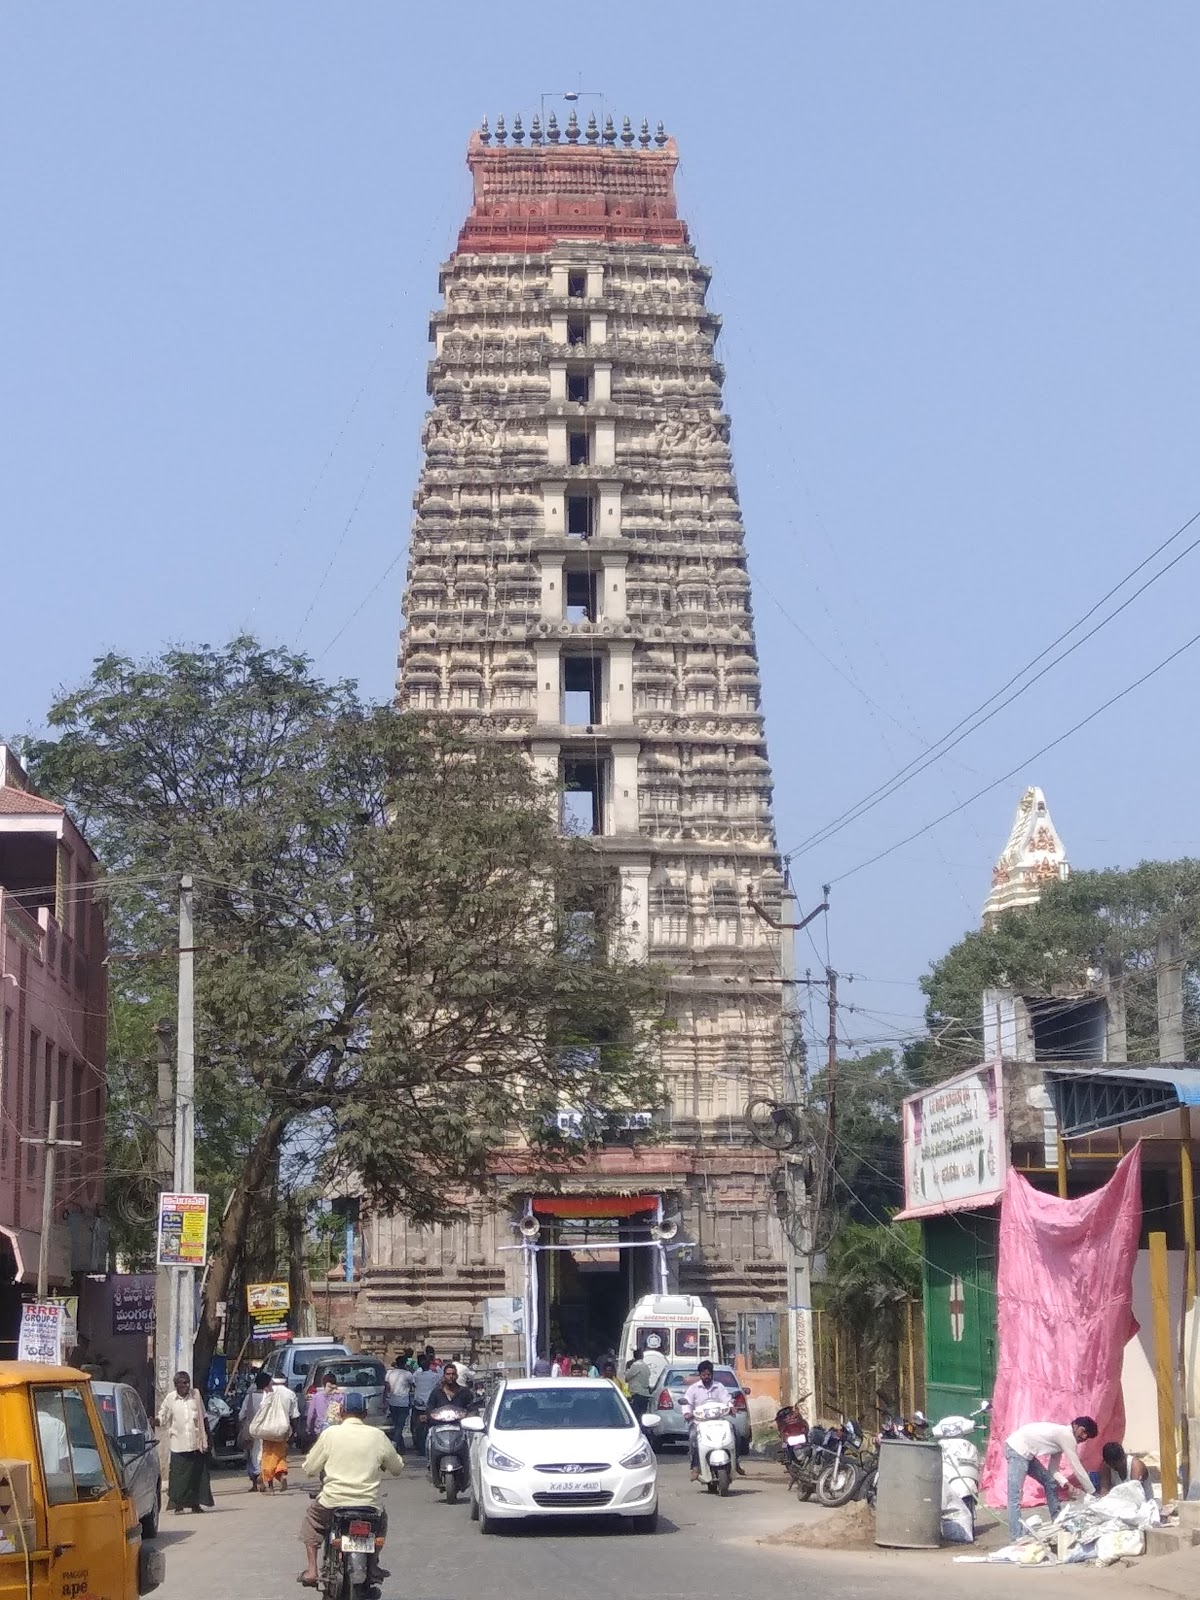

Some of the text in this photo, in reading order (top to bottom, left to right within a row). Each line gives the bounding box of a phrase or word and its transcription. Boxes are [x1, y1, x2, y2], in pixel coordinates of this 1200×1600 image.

[26, 1306, 58, 1316] RRB
[24, 1314, 58, 1324] GROUP-D
[62, 1582, 88, 1599] ape
